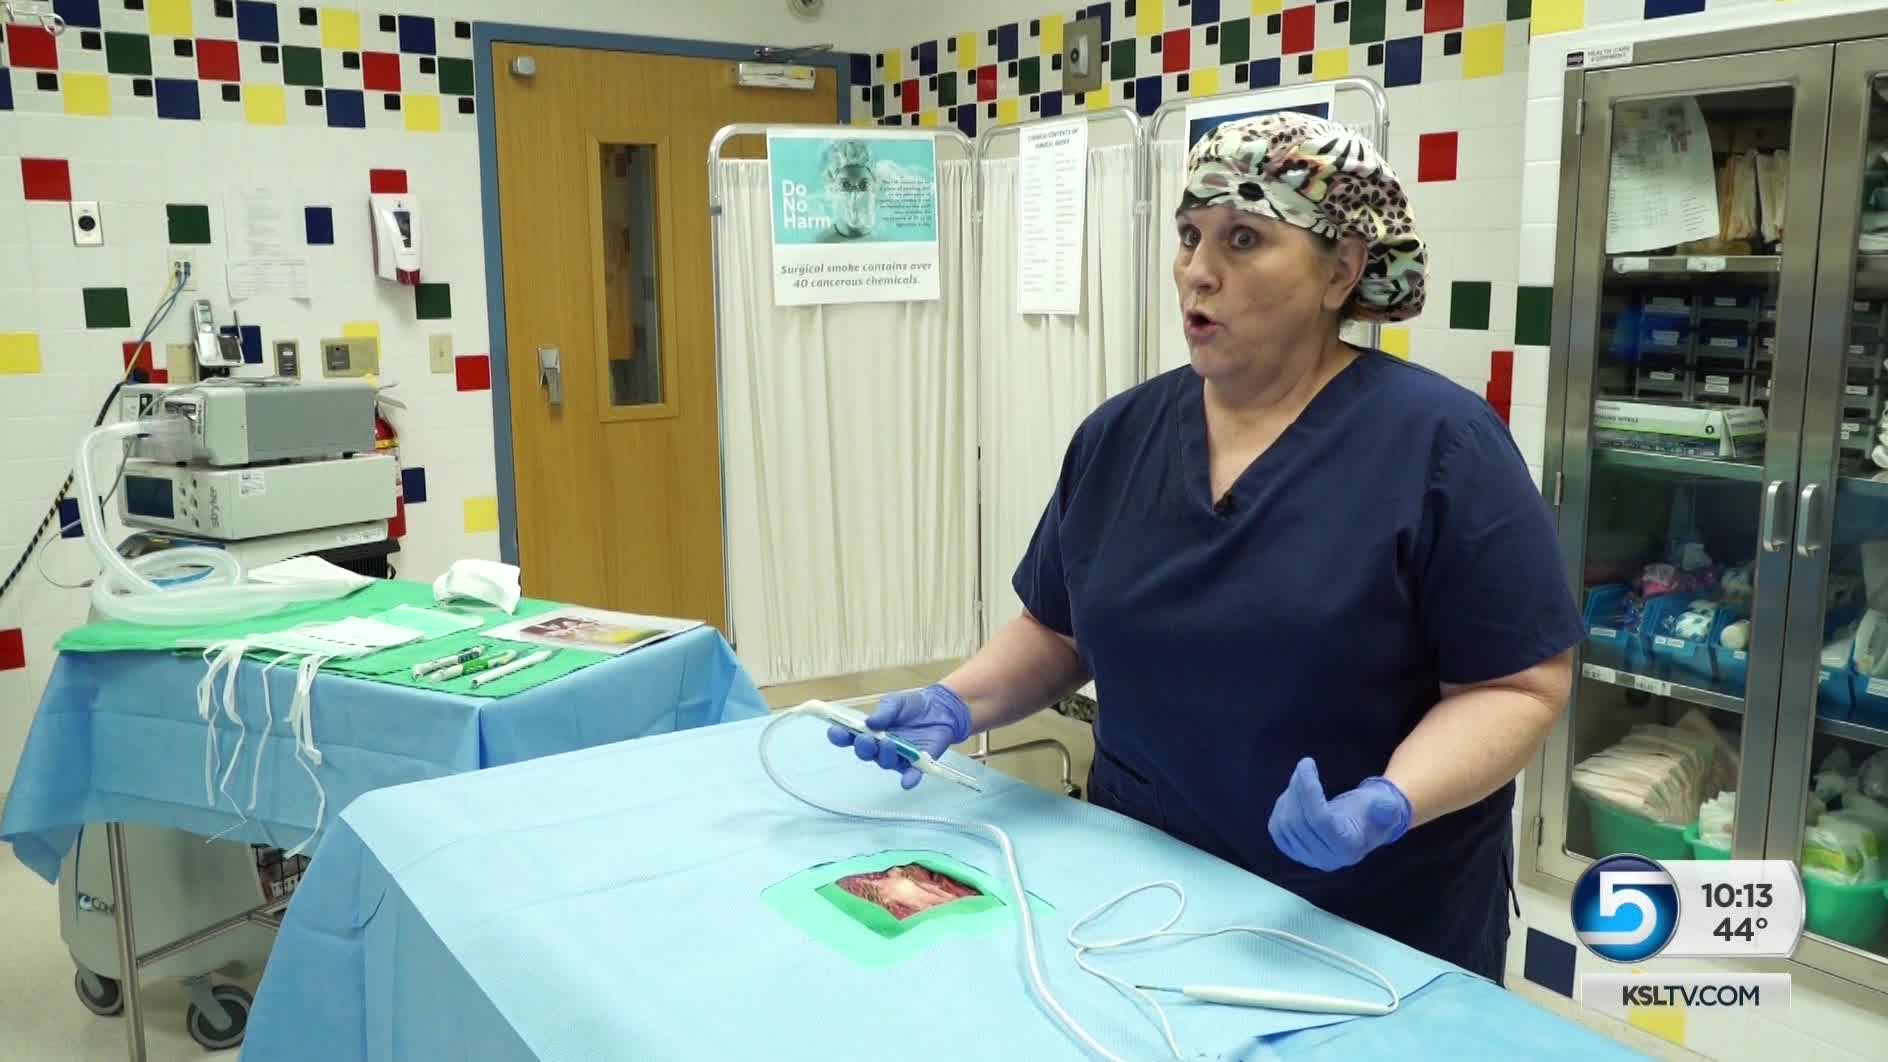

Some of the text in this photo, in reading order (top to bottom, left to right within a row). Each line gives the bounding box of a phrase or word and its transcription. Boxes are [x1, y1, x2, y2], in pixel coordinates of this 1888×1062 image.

[782, 180, 808, 196] Do
[783, 197, 808, 212] No
[783, 212, 832, 229] Harm
[780, 262, 932, 275] Surgical smoke contains over
[792, 273, 921, 288] 40 cancerous chemicals.
[208, 486, 221, 528] stryker
